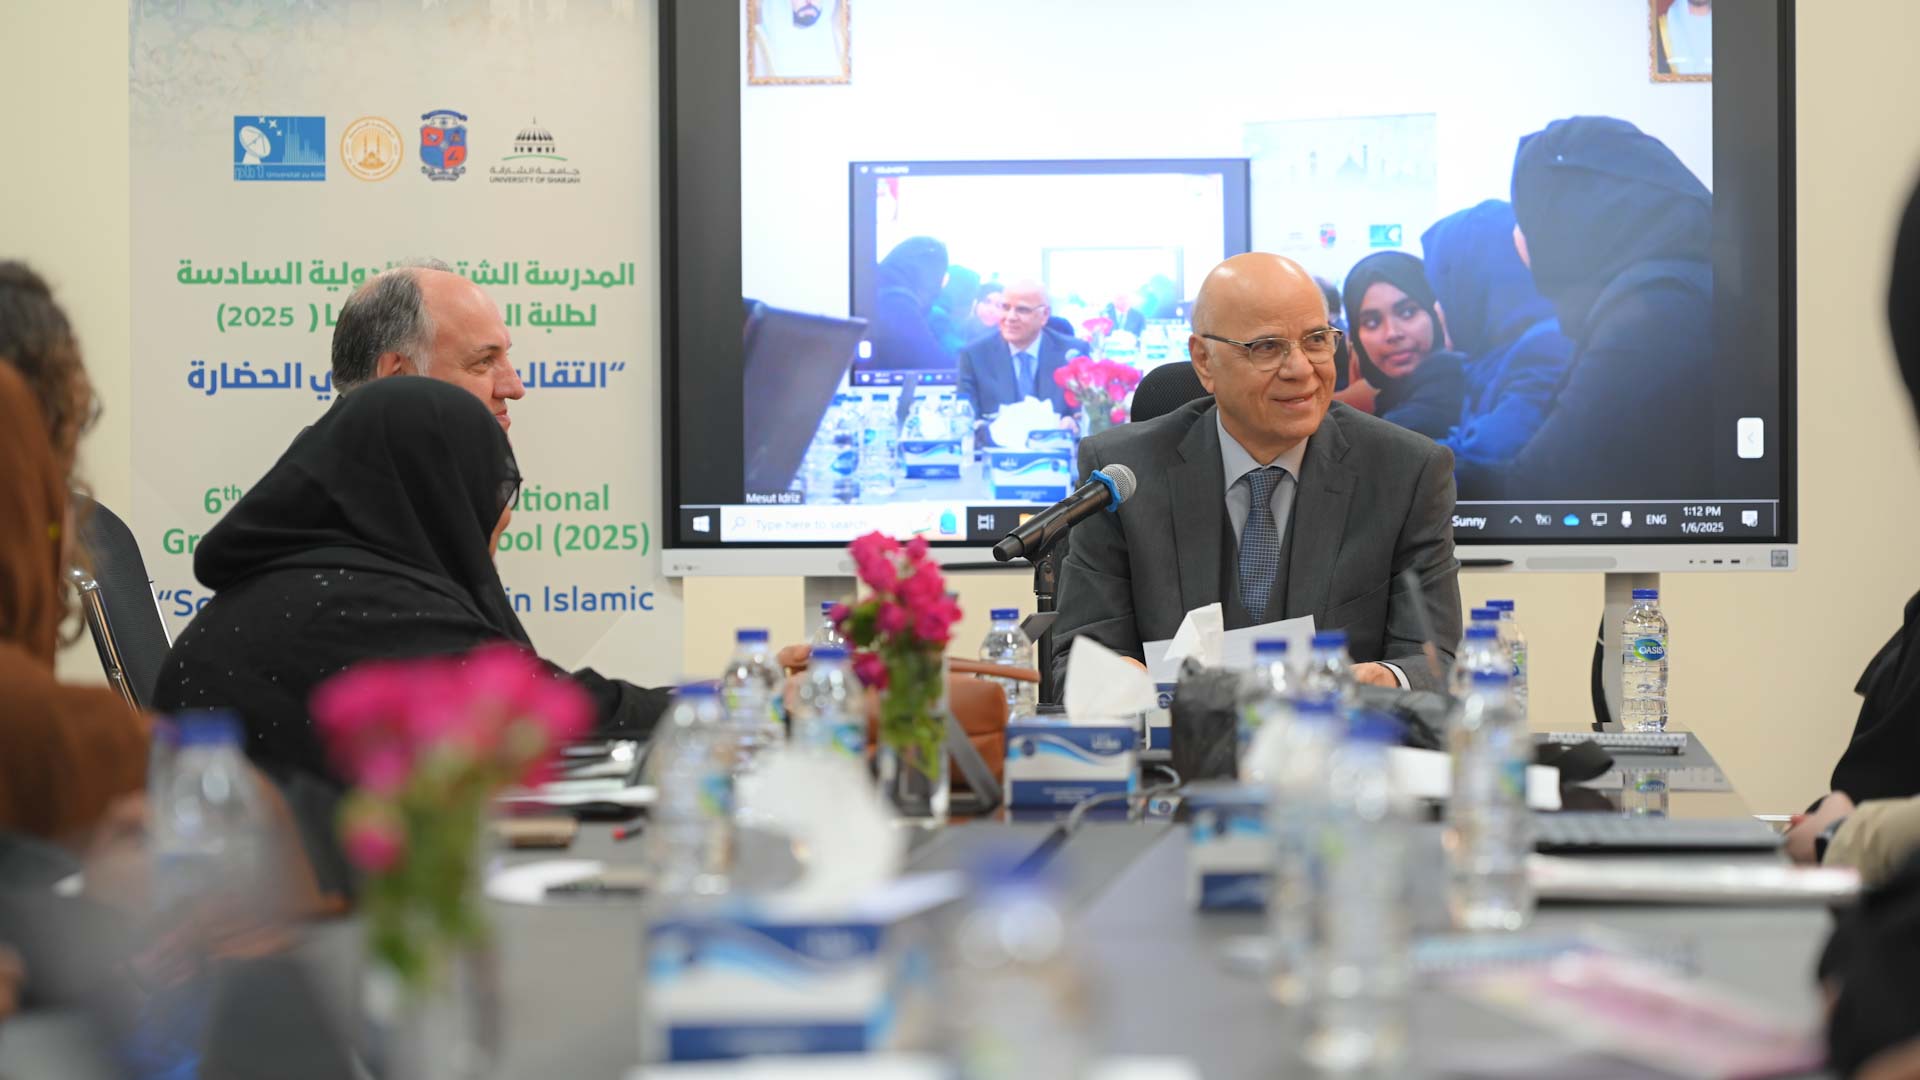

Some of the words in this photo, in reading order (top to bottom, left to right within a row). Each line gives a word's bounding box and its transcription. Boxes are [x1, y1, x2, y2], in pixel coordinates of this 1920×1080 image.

[489, 176, 533, 184] UNIVERSITY
[535, 176, 545, 184] OF
[547, 176, 581, 184] SHARJAH
[177, 259, 302, 285] السادسة
[525, 260, 635, 291] المدرسة
[528, 302, 596, 333] لطلبة
[187, 360, 302, 396] الحضارة
[203, 484, 243, 515] 6th
[746, 493, 777, 503] Mesut
[778, 493, 800, 503] Idriz
[1683, 505, 1704, 517] 1:12
[1705, 505, 1722, 517] PM
[757, 519, 782, 532] Type
[785, 519, 811, 529] here
[815, 519, 826, 529] to
[1451, 514, 1487, 530] Sunny
[1645, 514, 1668, 525] ENG
[1680, 522, 1725, 534] 1/6/2025
[553, 522, 650, 557] (2025)
[544, 586, 654, 612] Islamic
[1638, 646, 1664, 655] OASIS
